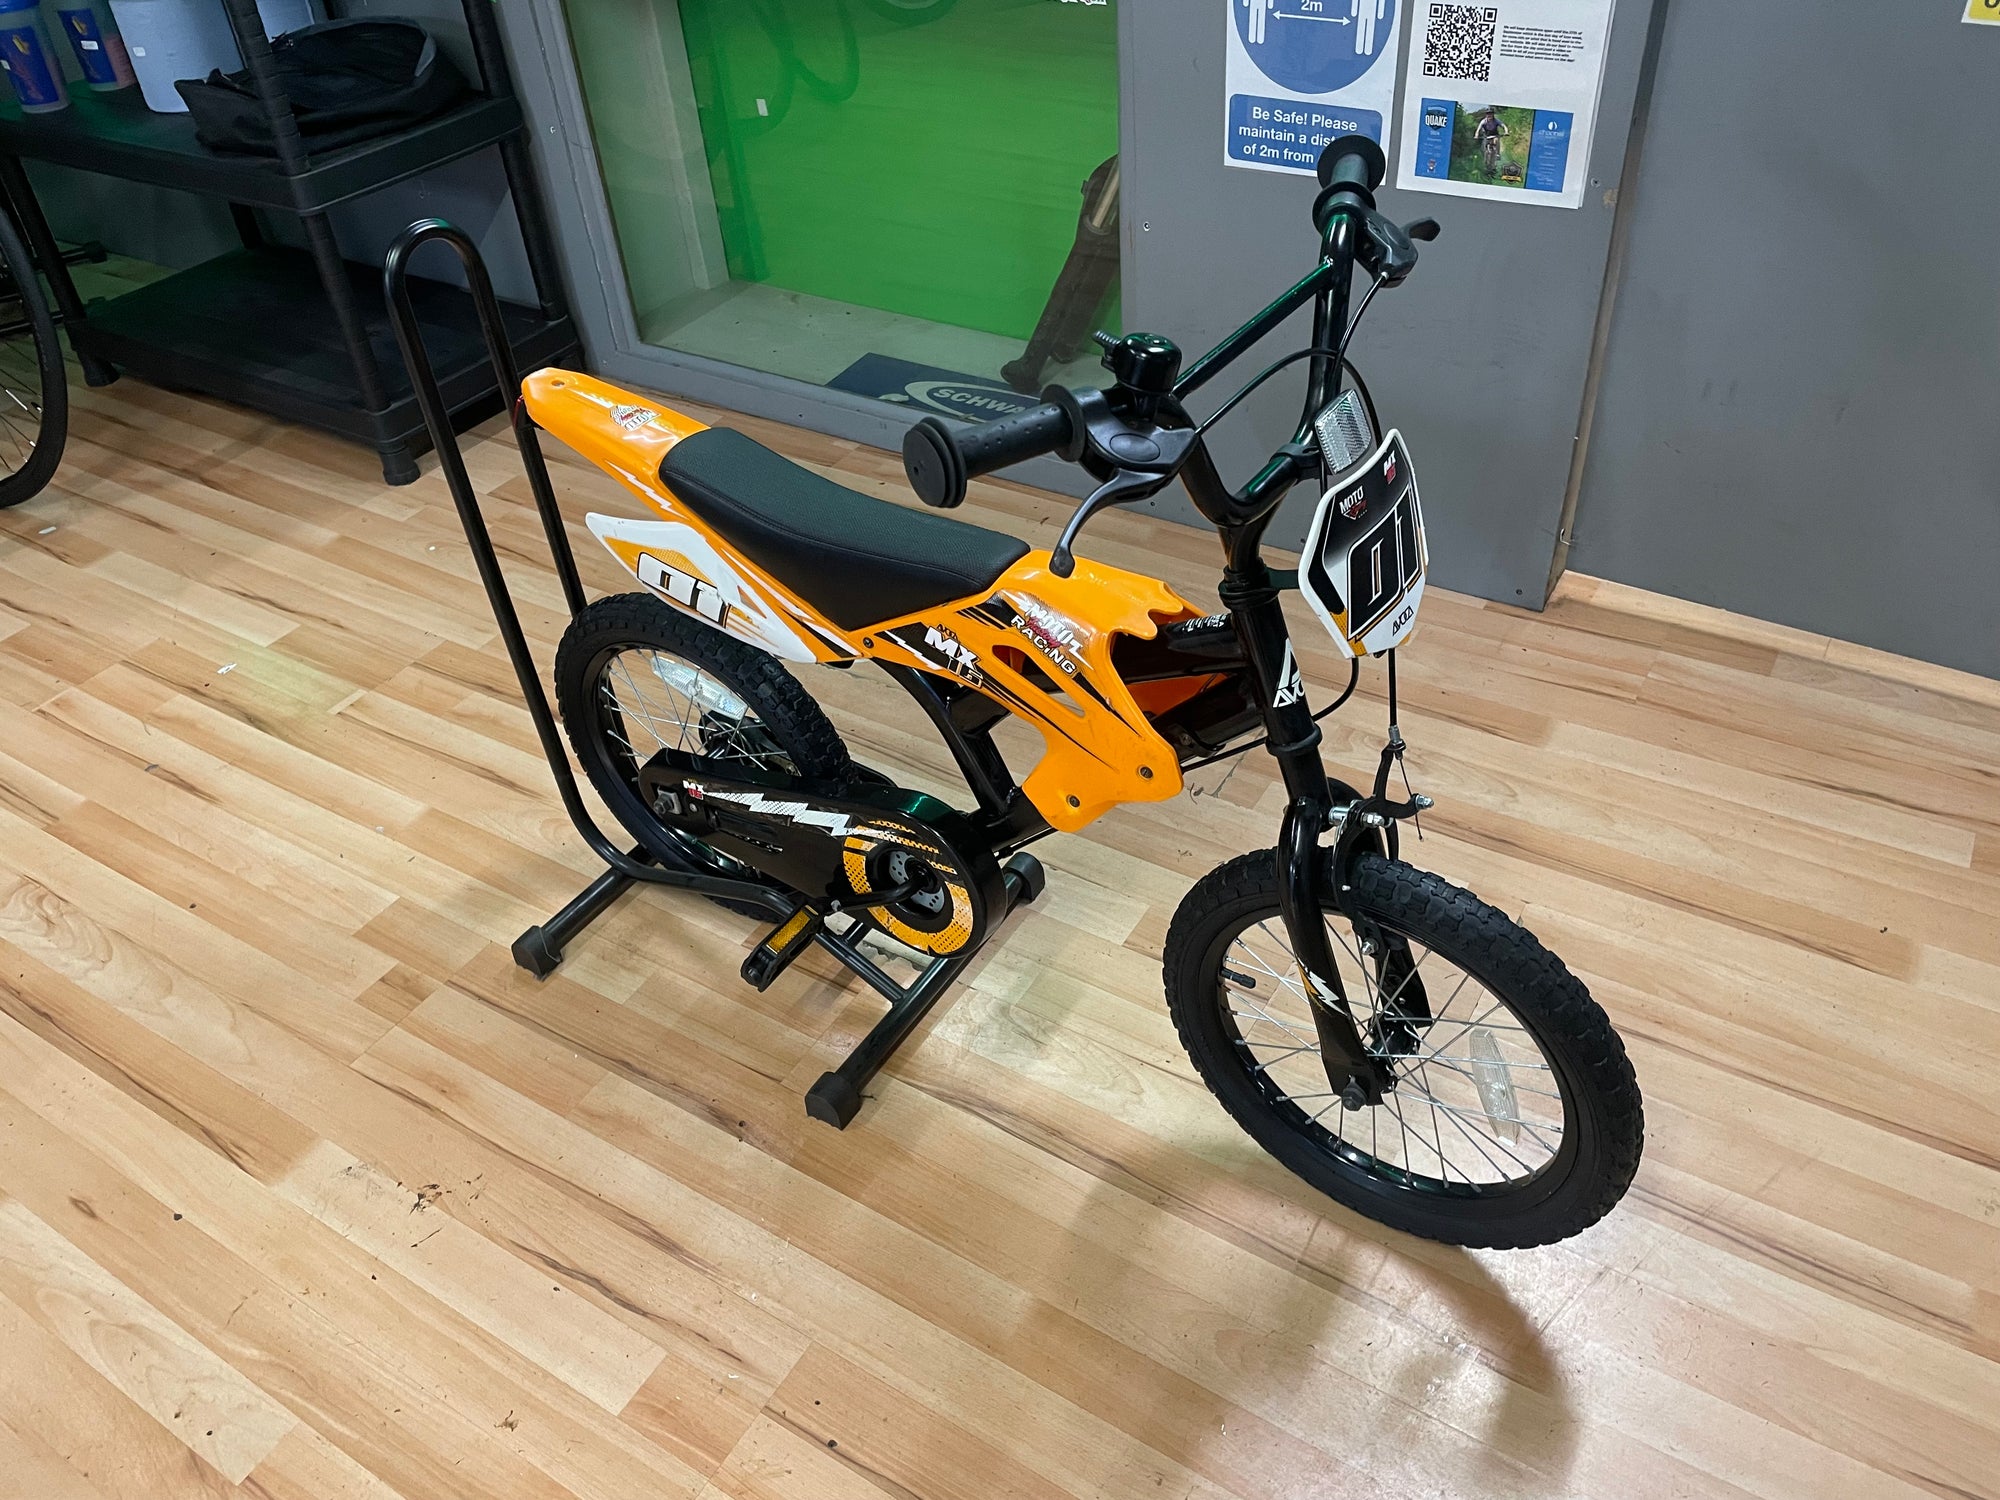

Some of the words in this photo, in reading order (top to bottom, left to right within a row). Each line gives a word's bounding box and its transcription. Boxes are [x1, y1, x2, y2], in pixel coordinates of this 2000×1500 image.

[1301, 0, 1322, 12] 2m
[1252, 106, 1270, 121] Be
[1273, 109, 1308, 125] Safe!
[1311, 114, 1358, 131] Please
[1425, 114, 1448, 127] QUAKE
[1238, 125, 1295, 142] maintain
[1298, 135, 1307, 144] a
[1243, 144, 1257, 155] of
[1259, 144, 1279, 159] 2m
[1283, 148, 1314, 163] from
[923, 625, 981, 673] MX
[1010, 614, 1077, 674] RACING
